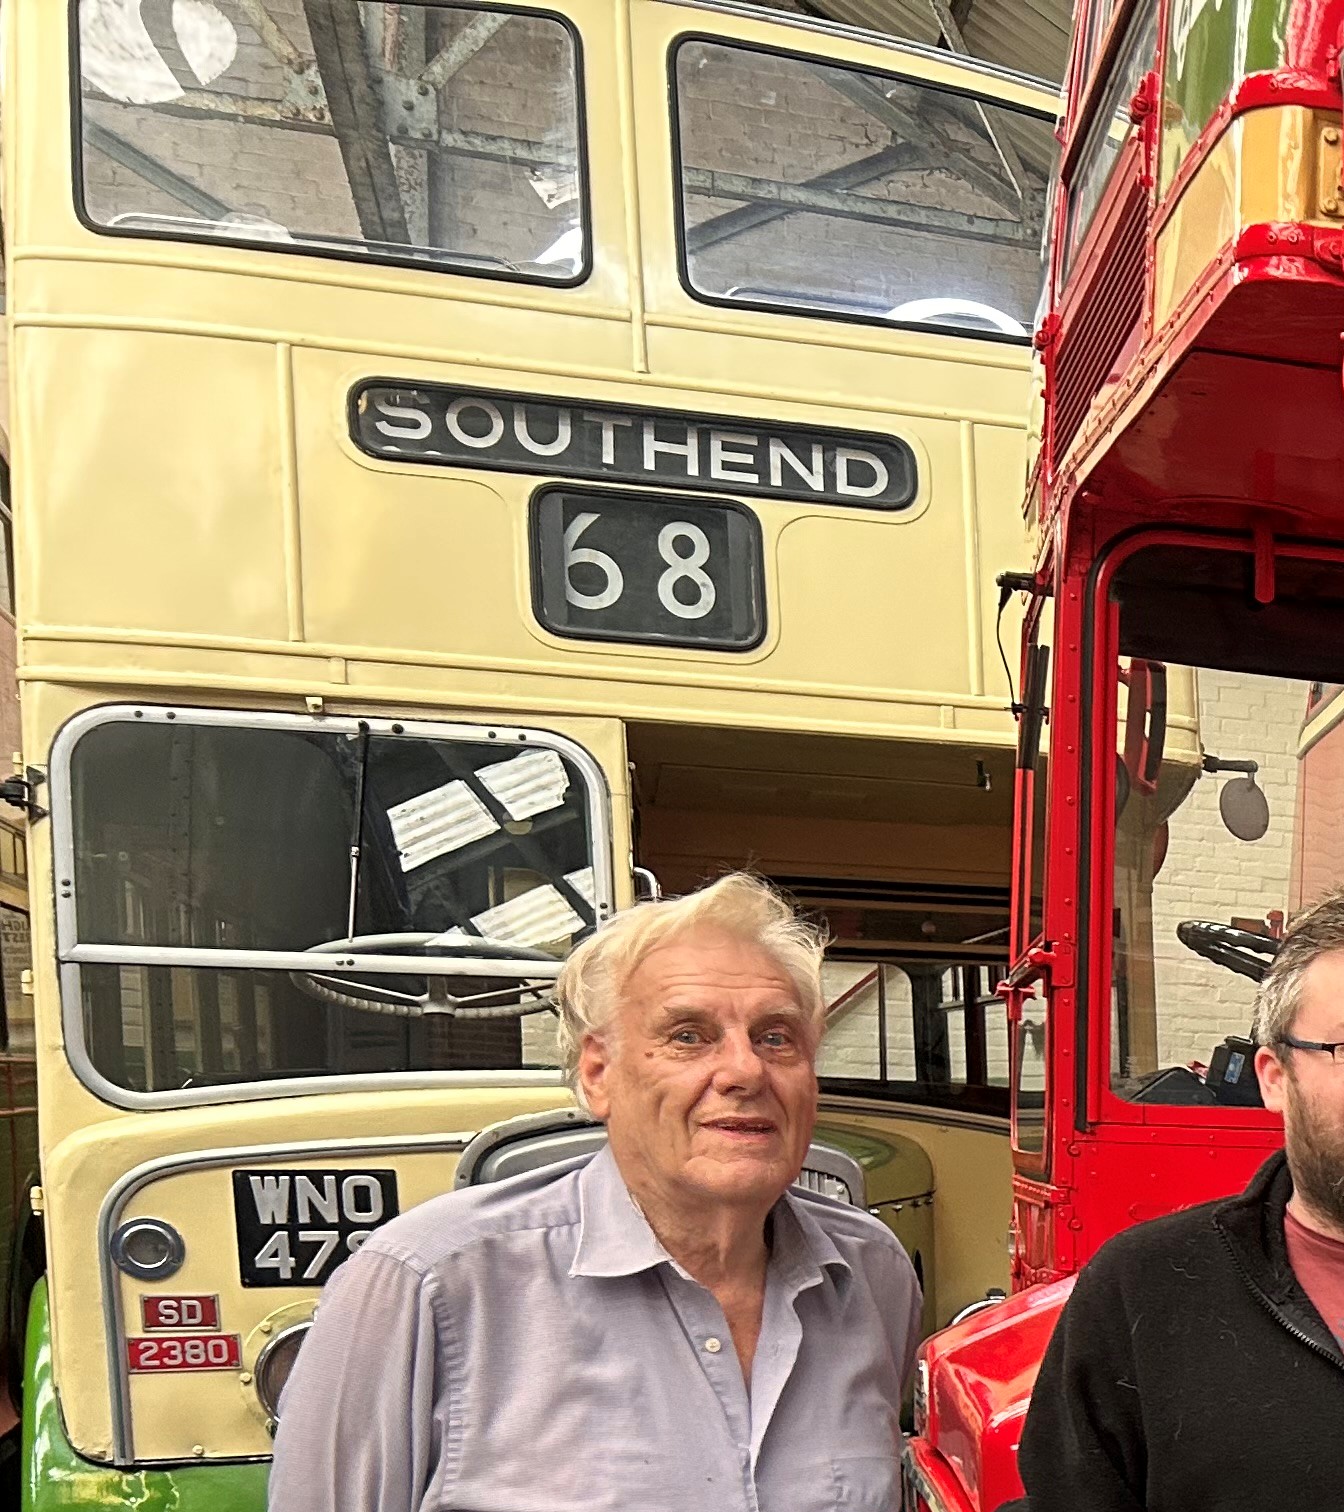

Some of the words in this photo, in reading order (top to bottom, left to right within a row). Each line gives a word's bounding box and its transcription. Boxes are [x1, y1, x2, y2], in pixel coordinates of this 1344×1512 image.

[374, 396, 890, 498] SOUTHEND
[564, 512, 717, 619] 68
[249, 1174, 384, 1225] WNO
[157, 1299, 204, 1326] SD
[137, 1338, 229, 1367] 2380
